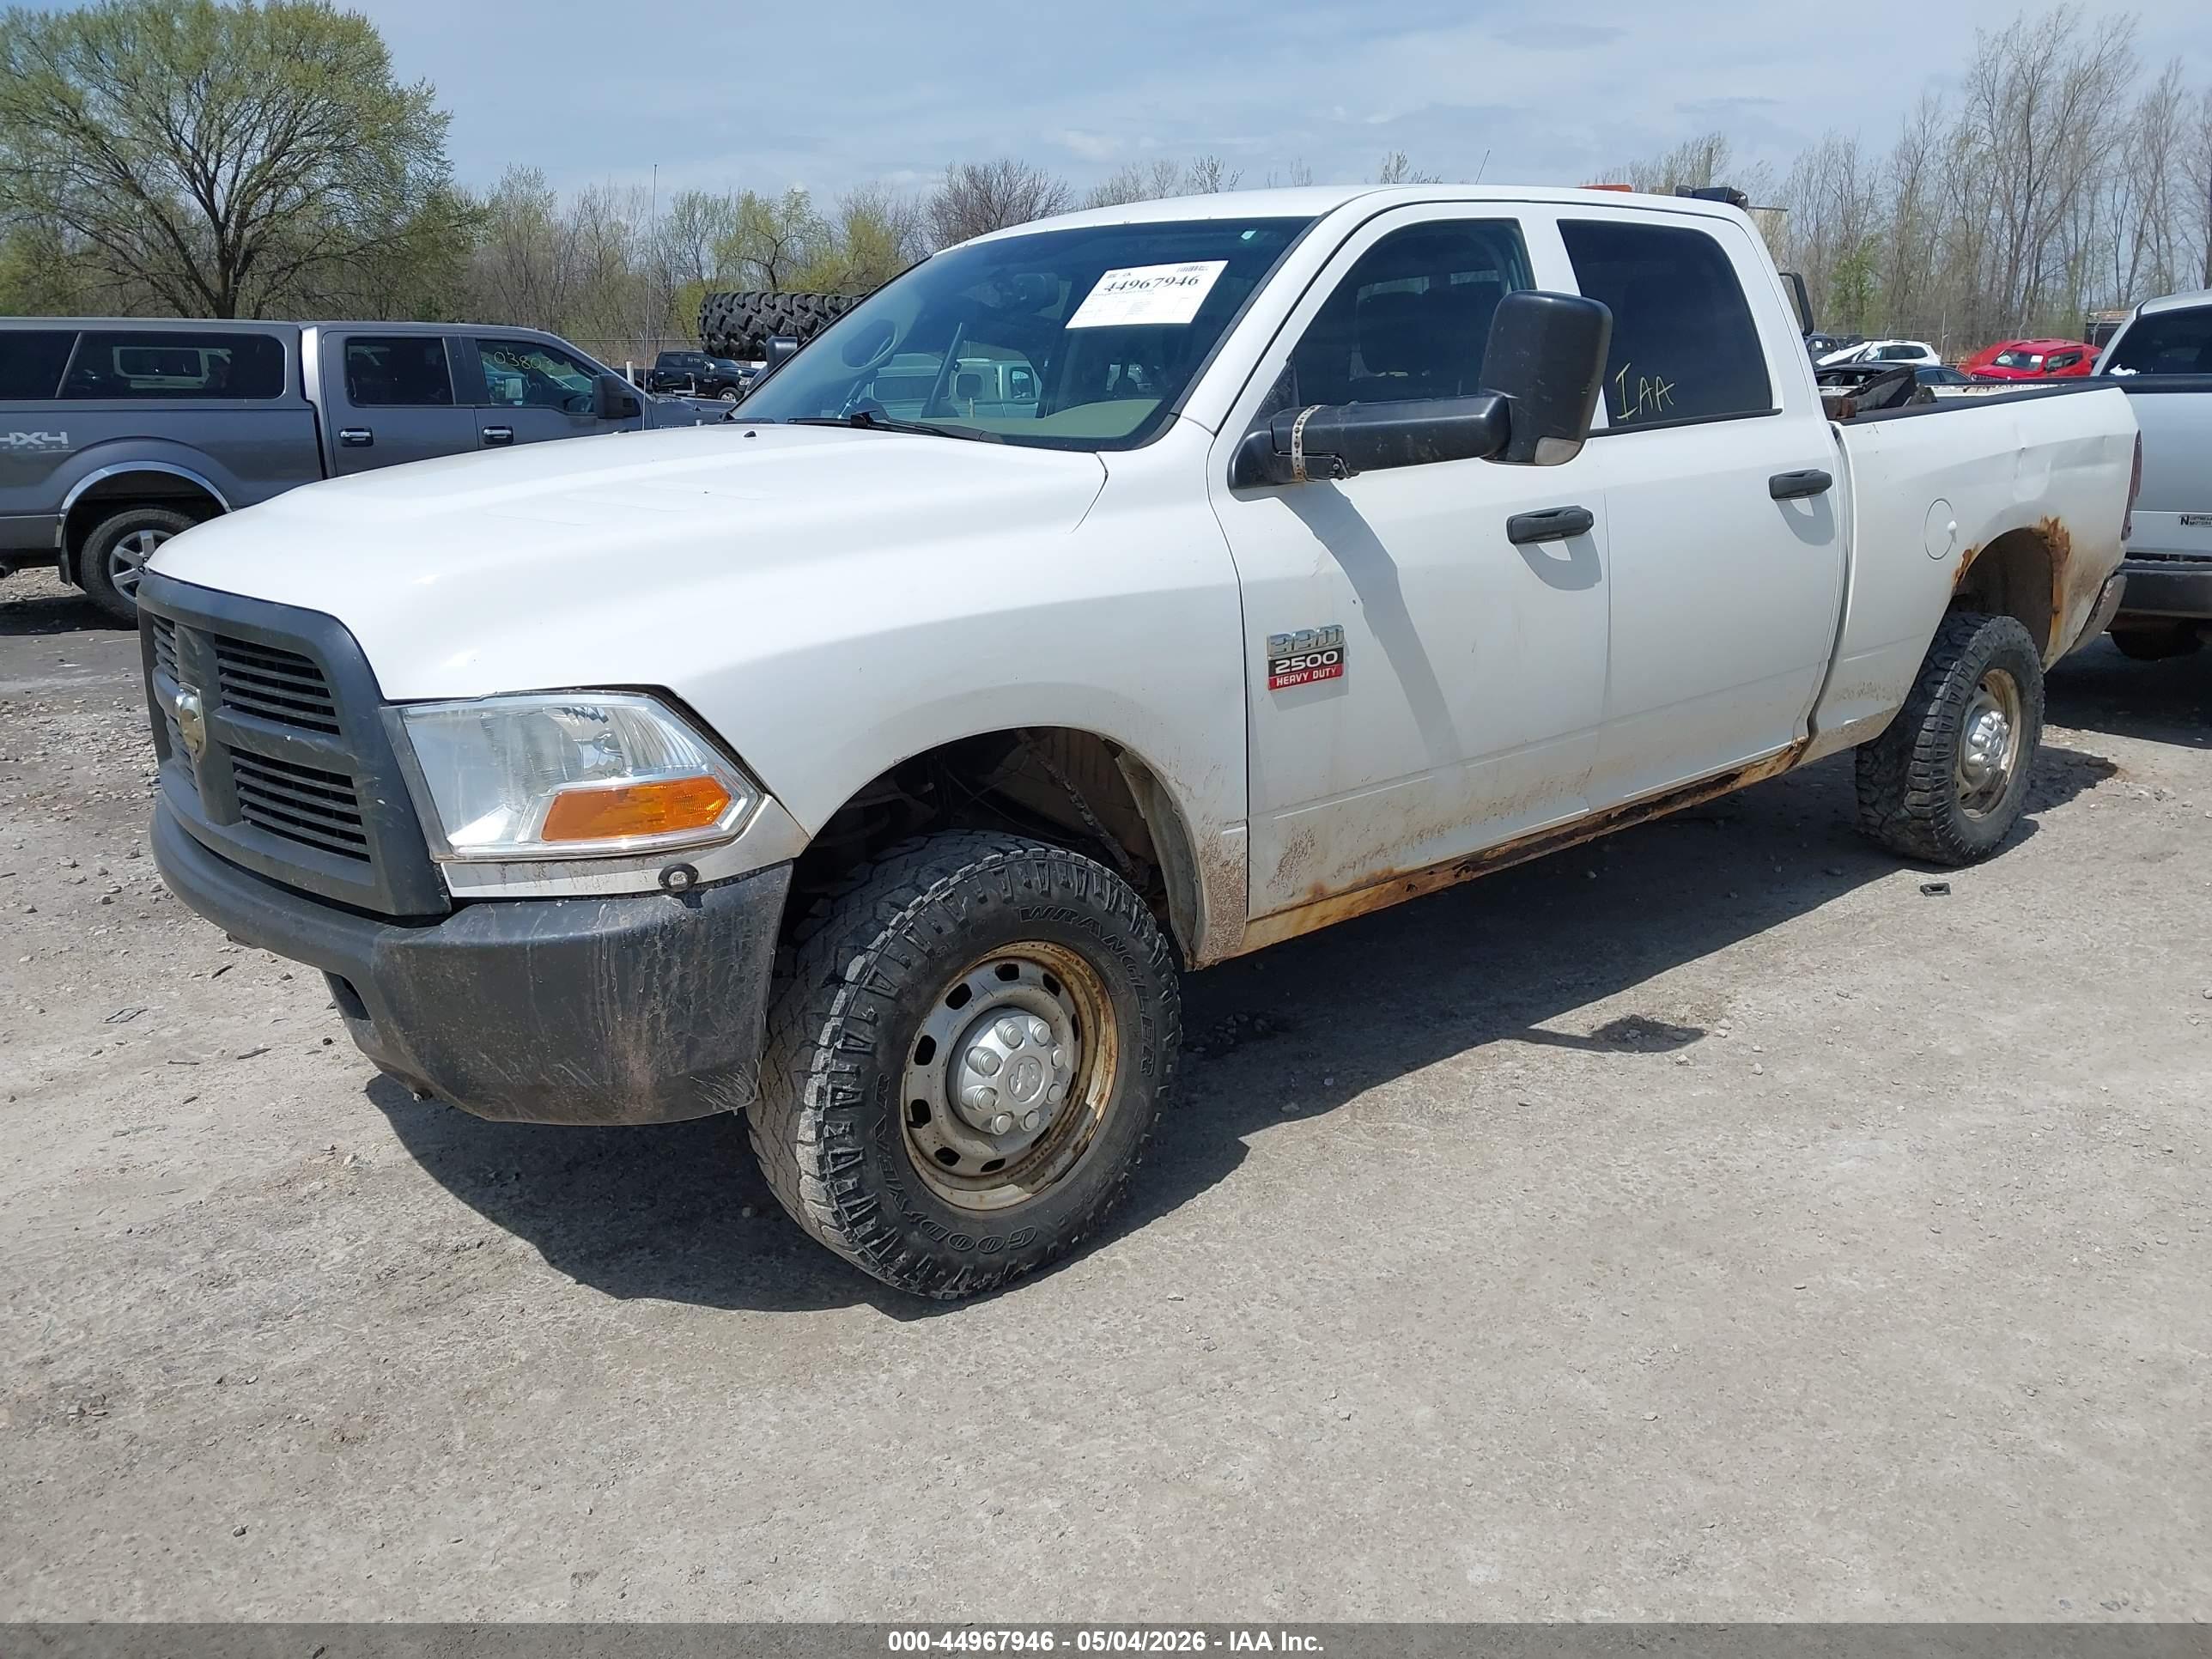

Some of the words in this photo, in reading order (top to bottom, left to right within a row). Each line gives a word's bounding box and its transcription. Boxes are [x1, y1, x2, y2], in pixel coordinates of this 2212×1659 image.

[1104, 274, 1200, 292] 44967946
[1615, 362, 1675, 421] IAA
[1275, 650, 1339, 675] 2500
[1276, 672, 1310, 687] HEAVY
[1312, 666, 1337, 680] DUTY
[1018, 905, 1156, 1077] WRANGLER
[873, 1073, 1037, 1254] GOODYEAR
